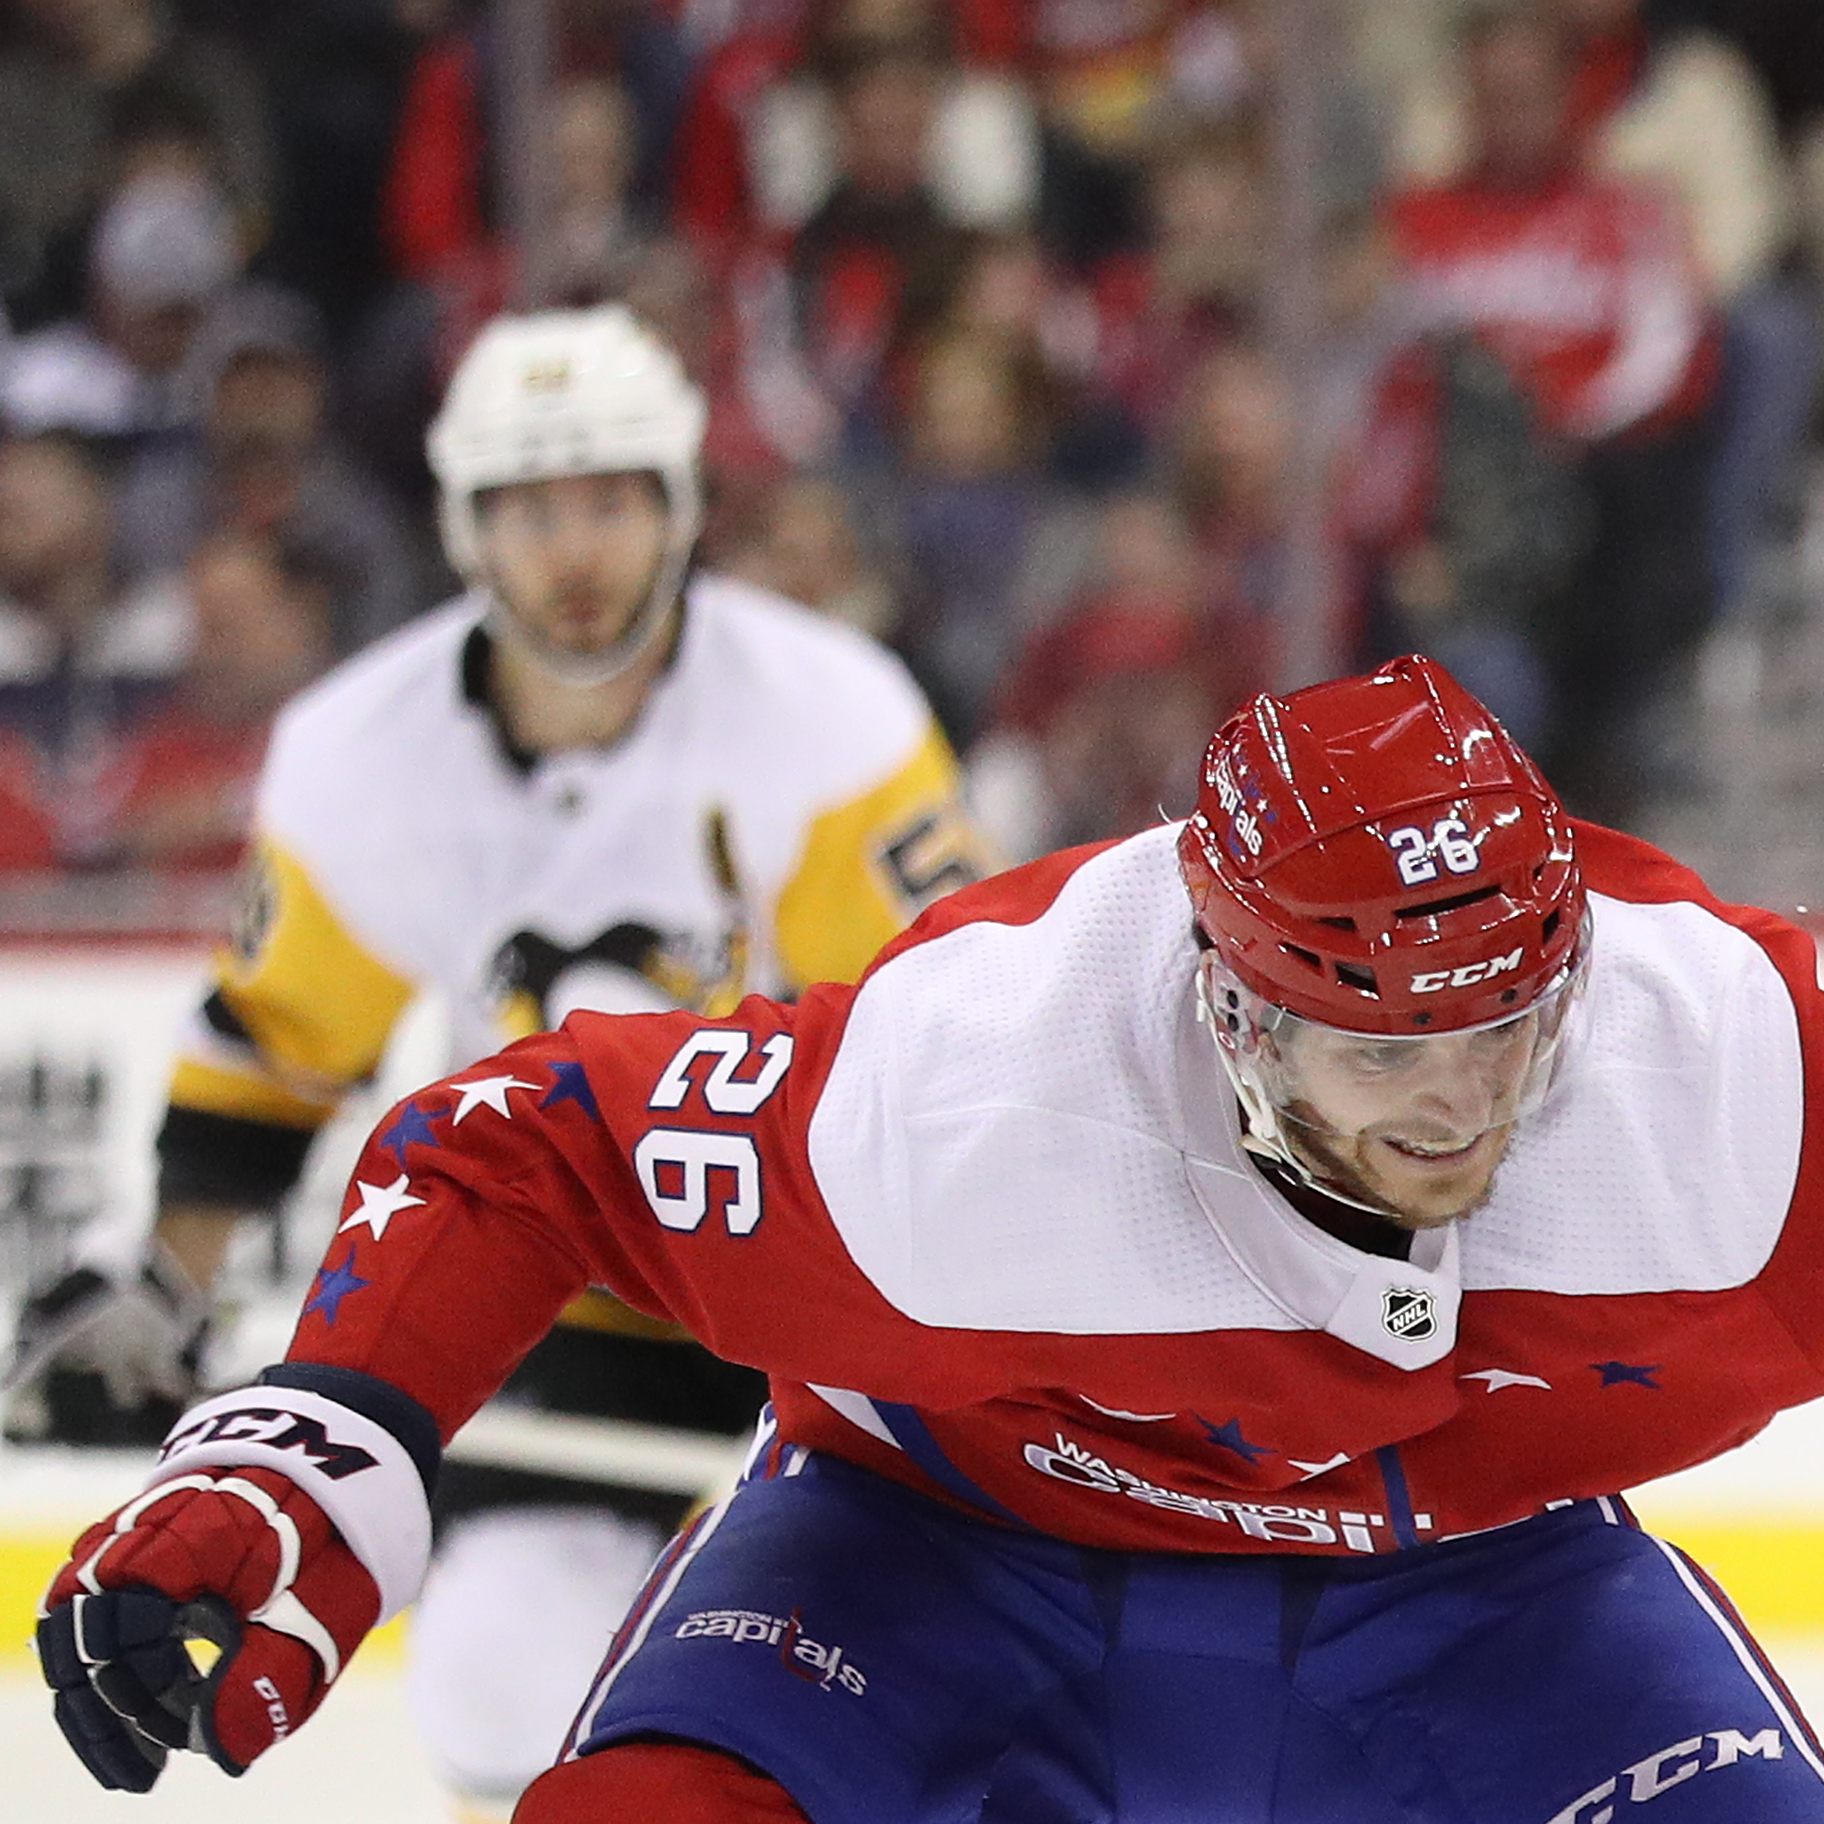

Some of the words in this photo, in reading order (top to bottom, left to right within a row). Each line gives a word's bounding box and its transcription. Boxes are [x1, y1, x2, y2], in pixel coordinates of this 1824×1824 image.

[1389, 818, 1481, 886] 26
[1410, 946, 1524, 993] CCM
[632, 1027, 797, 1238] 26
[1392, 1303, 1427, 1331] NHL
